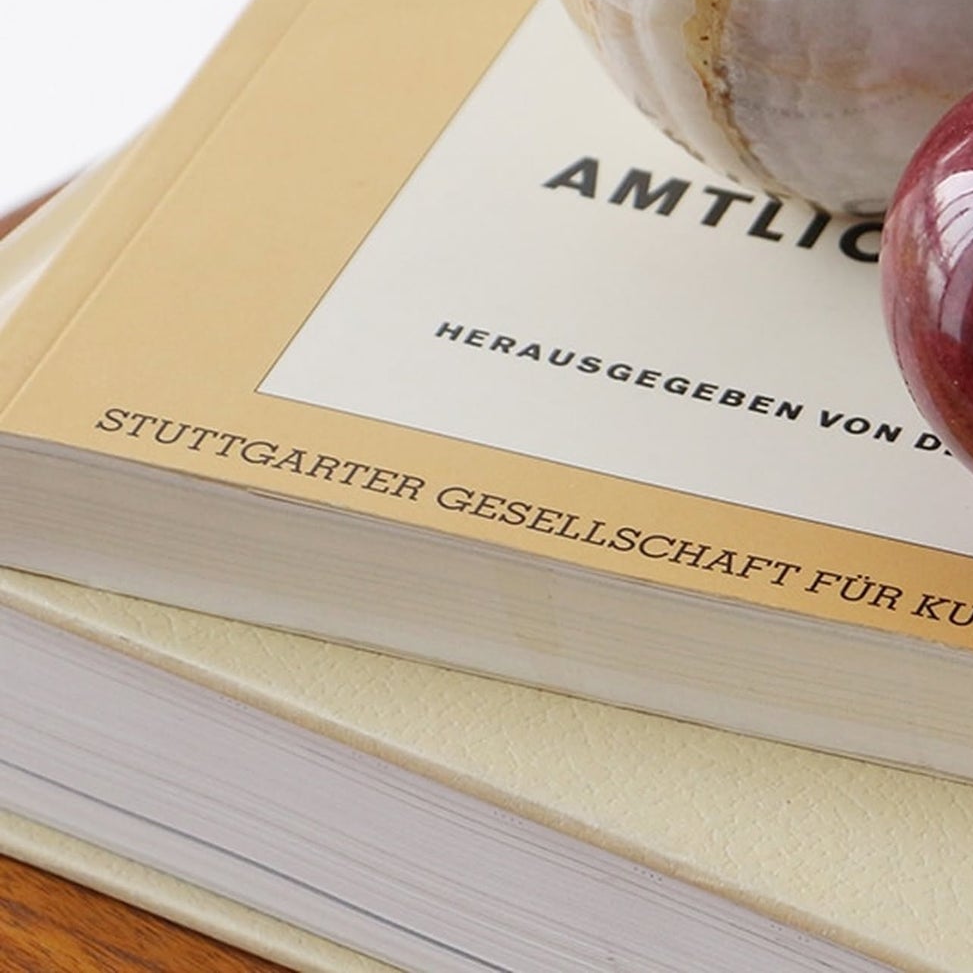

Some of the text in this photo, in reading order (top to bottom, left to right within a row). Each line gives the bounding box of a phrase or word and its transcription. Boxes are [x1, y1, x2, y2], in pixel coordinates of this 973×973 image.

[436, 323, 803, 420] HERAUSGEGEBEN
[821, 411, 902, 442] VON
[915, 433, 952, 456] D
[95, 409, 425, 501] STUTTGARTER
[437, 487, 802, 586] GESELLSCHAFT
[805, 571, 903, 611] FÜR
